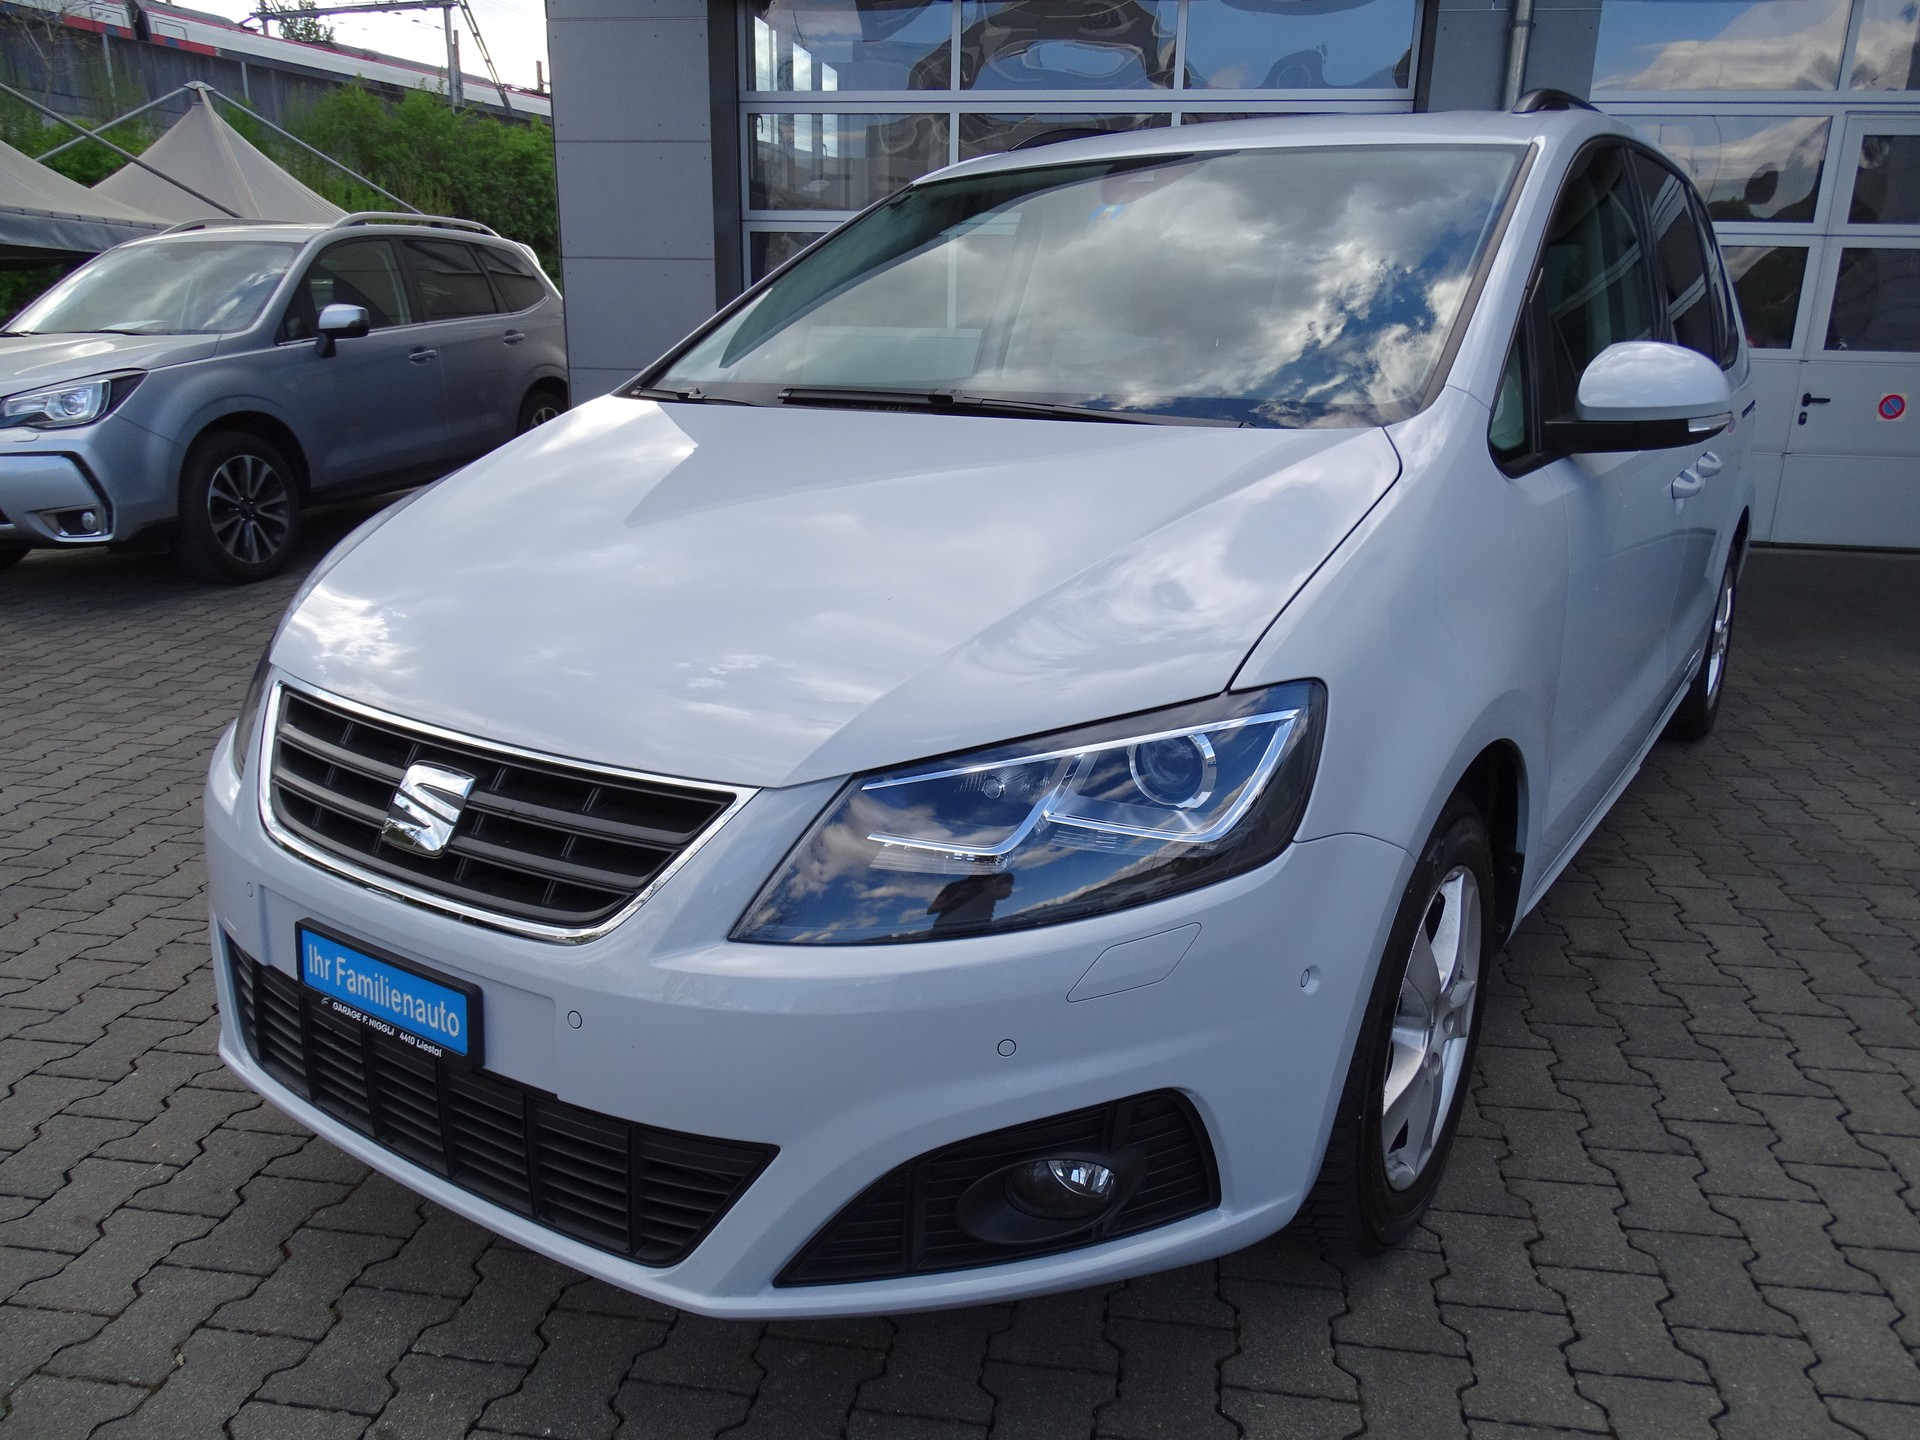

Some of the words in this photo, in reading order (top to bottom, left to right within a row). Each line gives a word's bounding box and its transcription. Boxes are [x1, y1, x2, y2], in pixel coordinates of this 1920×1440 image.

[308, 943, 331, 981] Ihr
[336, 956, 460, 1038] Familienauto
[332, 1001, 362, 1021] GARAGE
[362, 1015, 369, 1025] F.
[369, 1019, 395, 1036] NIGGLI
[399, 1031, 415, 1046] 4410
[416, 1039, 442, 1058] Liestal
